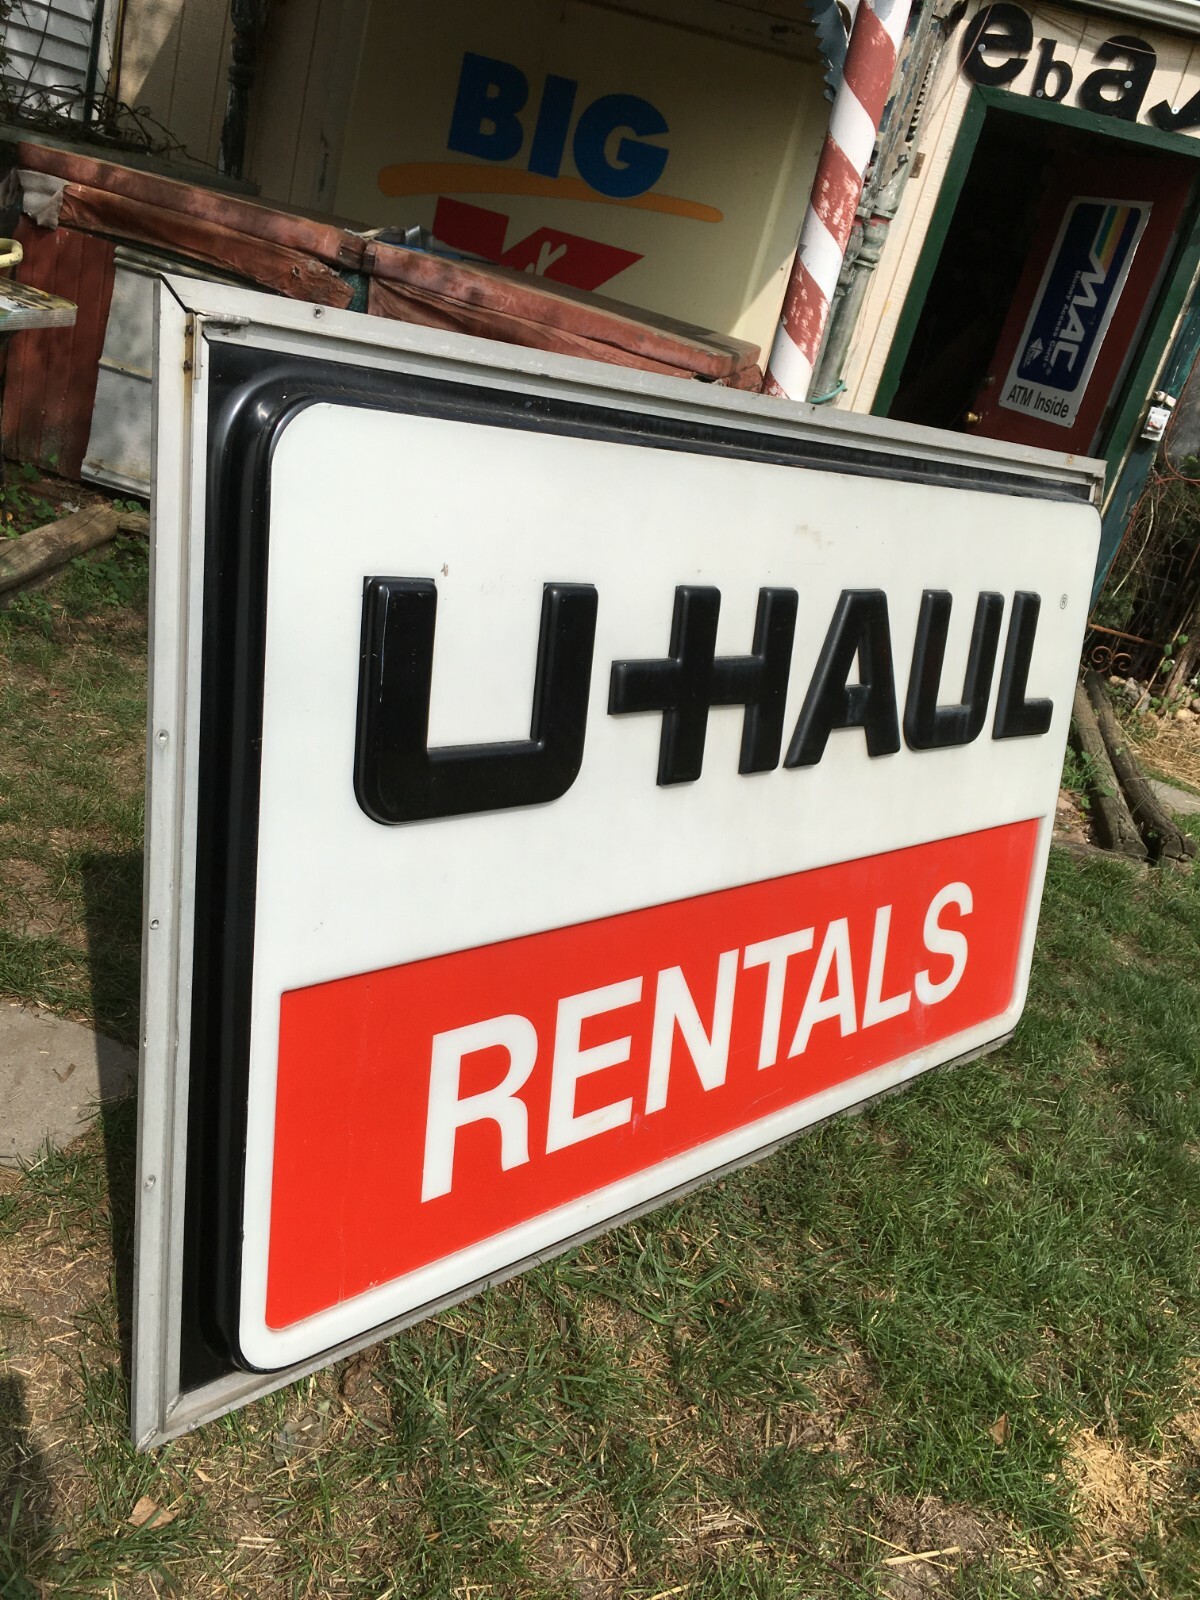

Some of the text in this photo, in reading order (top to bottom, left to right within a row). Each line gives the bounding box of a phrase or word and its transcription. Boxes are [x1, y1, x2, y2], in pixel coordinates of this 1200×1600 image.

[447, 52, 670, 198] BIG
[1044, 270, 1081, 361] Money Access Card
[1049, 254, 1107, 373] MAC
[1007, 384, 1070, 418] ATM Inside
[353, 575, 1053, 826] U-HAUL
[421, 882, 973, 1204] RENTALS
